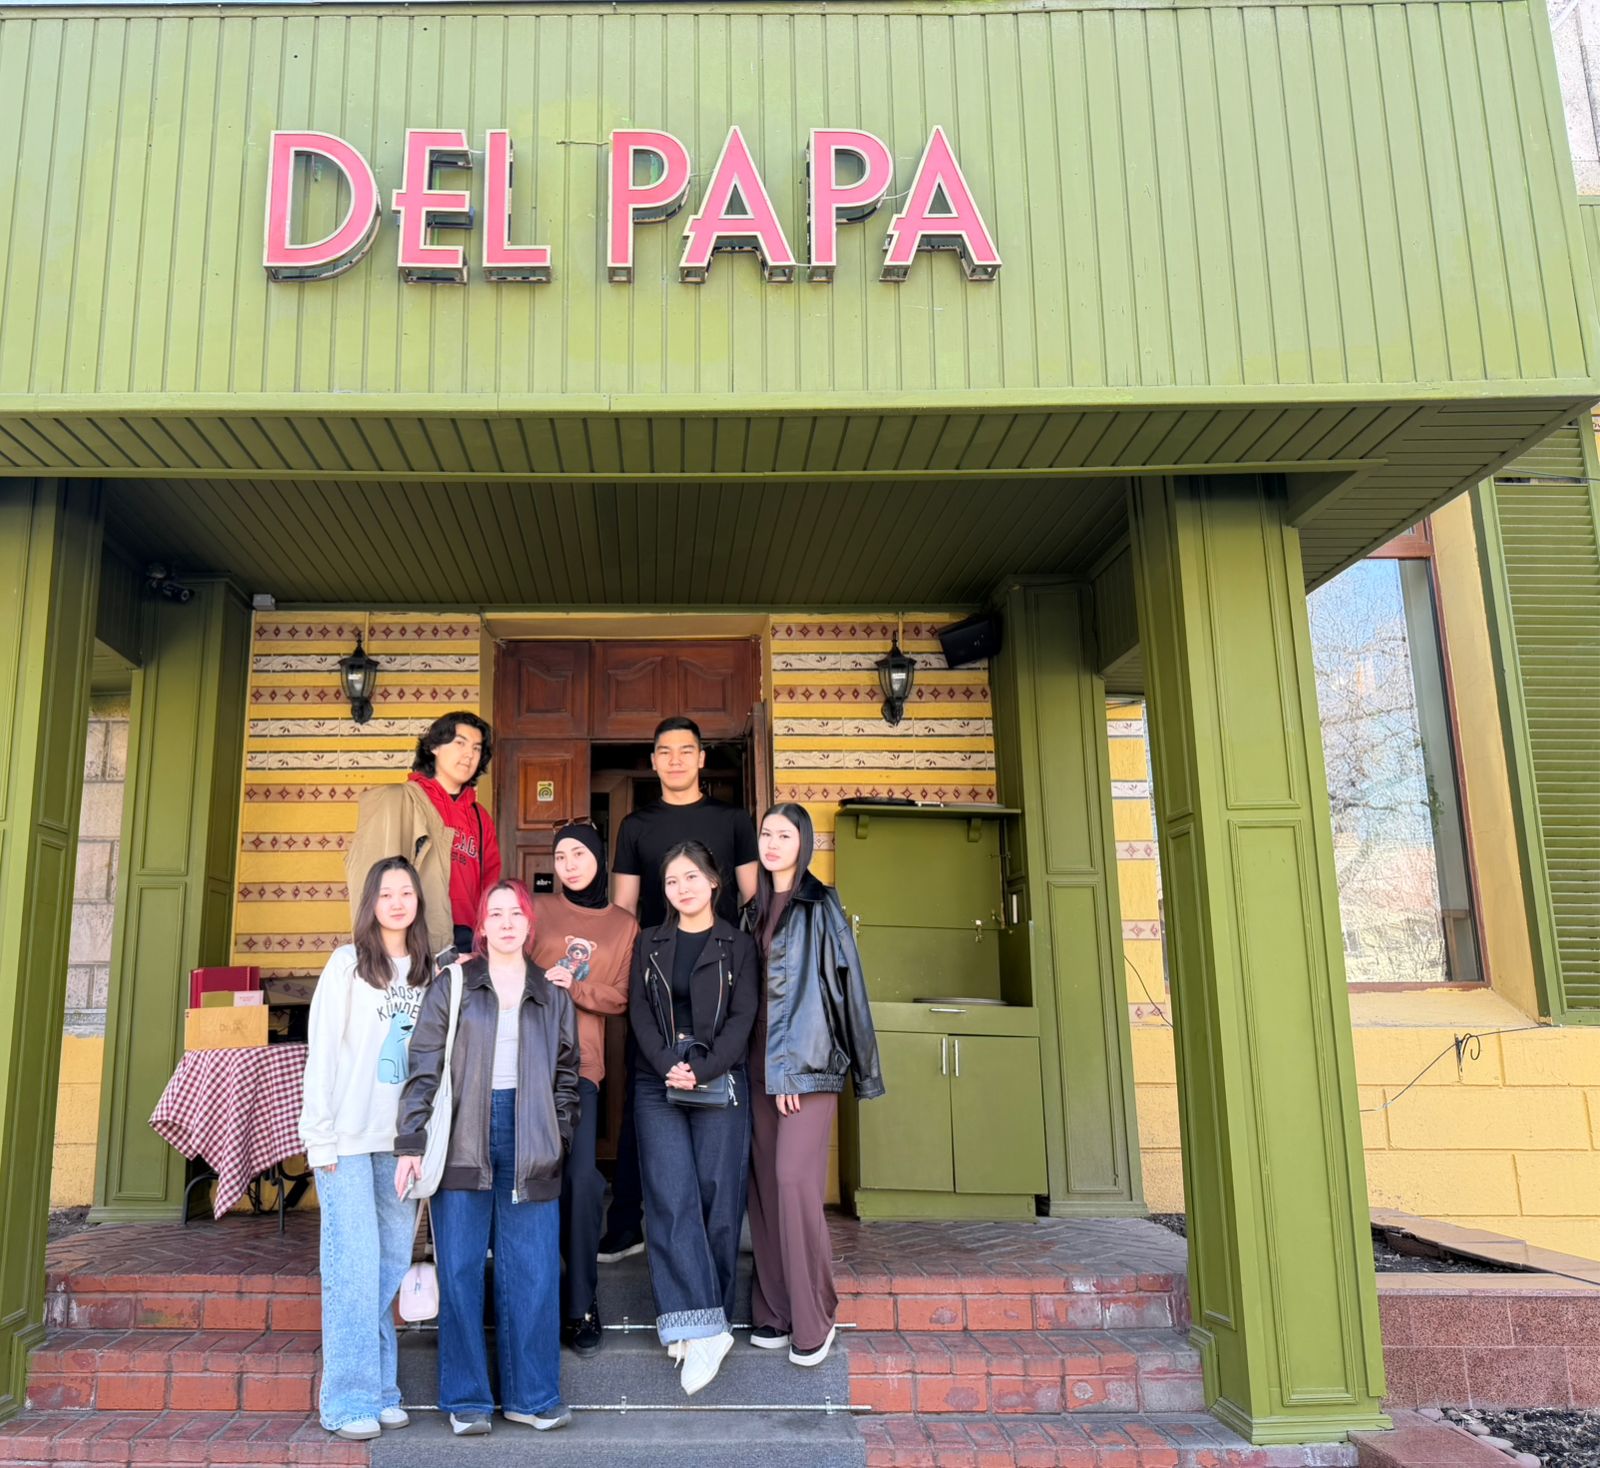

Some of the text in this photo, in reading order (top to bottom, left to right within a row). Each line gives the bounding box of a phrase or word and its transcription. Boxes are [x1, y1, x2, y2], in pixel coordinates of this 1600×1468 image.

[262, 124, 1003, 283] DEL PAPA
[383, 985, 422, 1002] JAQSY
